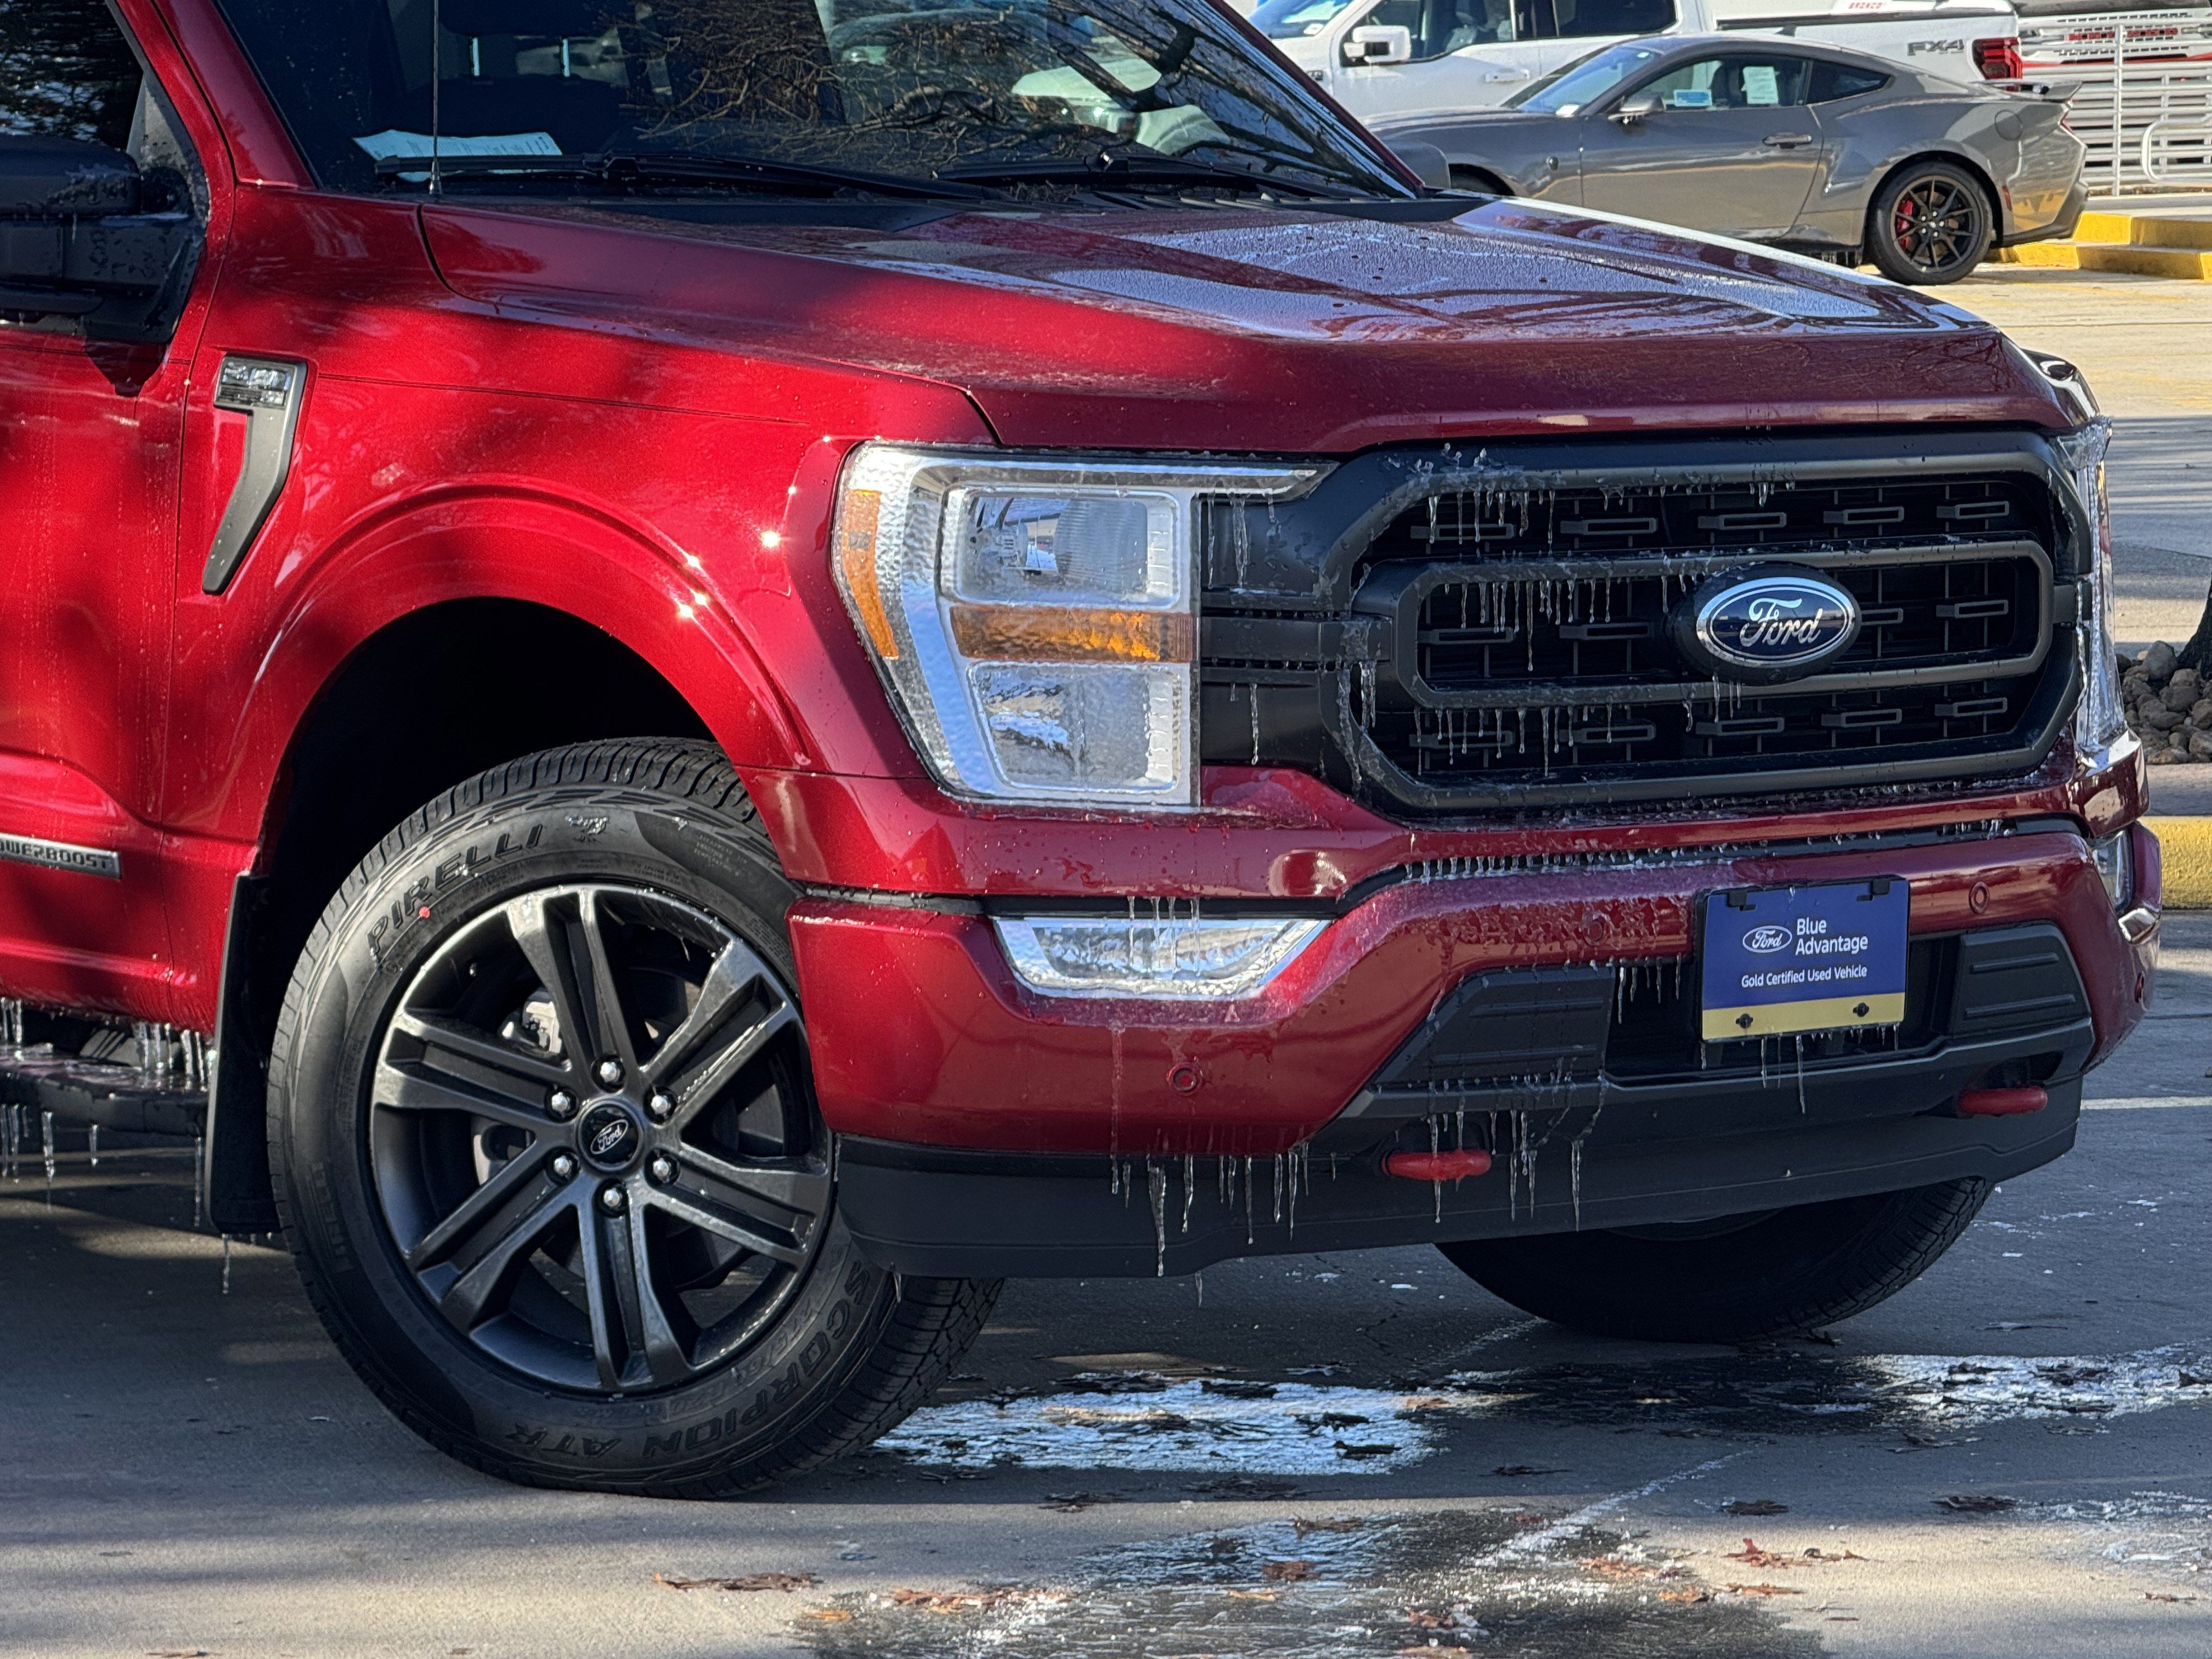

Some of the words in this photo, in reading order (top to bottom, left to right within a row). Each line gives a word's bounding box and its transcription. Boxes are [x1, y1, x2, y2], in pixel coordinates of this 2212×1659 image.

[1907, 39, 1964, 55] FX4
[1739, 597, 1824, 647] Ford
[366, 823, 544, 953] PIRELLI
[1797, 917, 1827, 936] Blue
[1752, 929, 1782, 950] Ford
[1795, 935, 1869, 956] Advantage
[1741, 974, 1764, 988] Gold
[1766, 969, 1805, 986] Certified
[1808, 966, 1832, 982] Used
[1834, 964, 1868, 979] Vehicle
[597, 1124, 623, 1151] Ford
[642, 1261, 869, 1458] SCORPION
